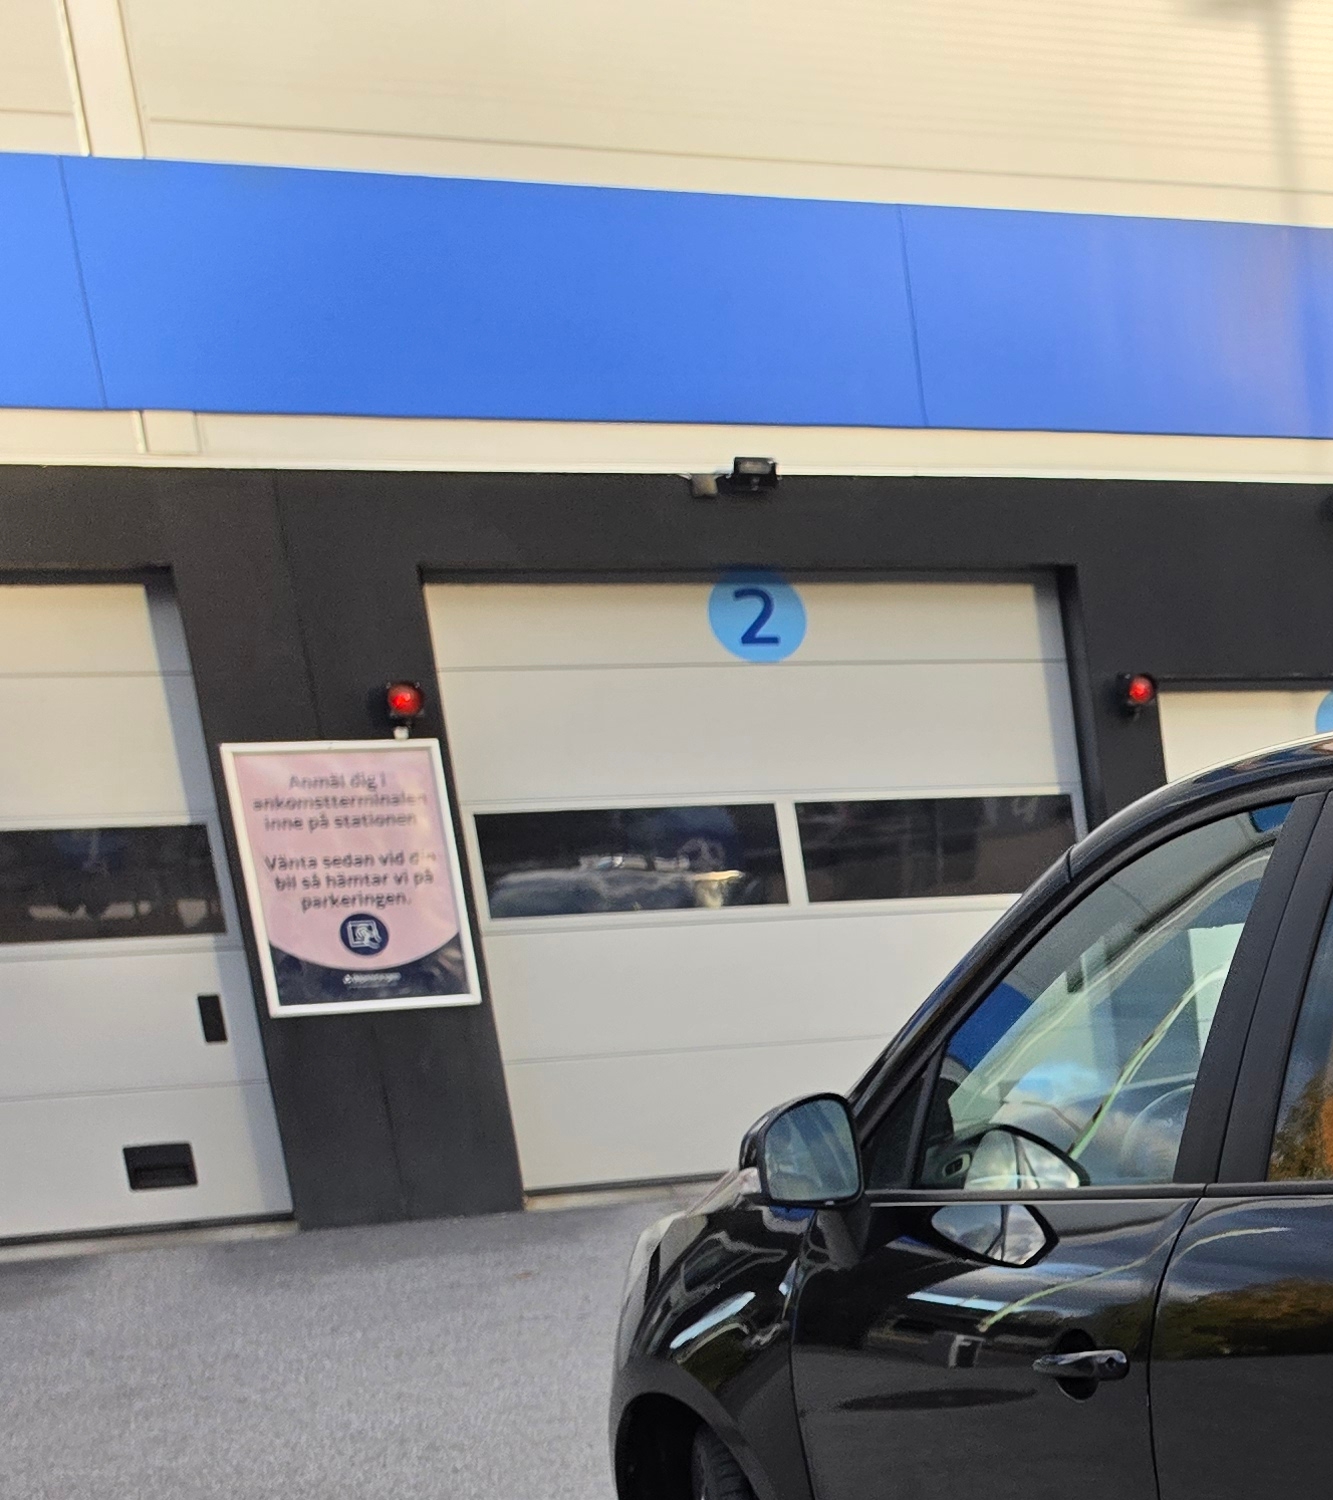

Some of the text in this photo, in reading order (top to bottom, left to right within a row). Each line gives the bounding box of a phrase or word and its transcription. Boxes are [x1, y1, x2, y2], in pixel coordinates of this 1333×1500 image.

[732, 587, 781, 645] 2
[289, 772, 345, 790] Anmäl
[350, 772, 377, 791] dig
[264, 815, 304, 831] inne
[307, 812, 330, 834] på
[264, 854, 317, 872] Vänta
[322, 851, 375, 869] sedan
[378, 850, 404, 867] vid
[274, 868, 435, 892] bil så hämtar vi på
